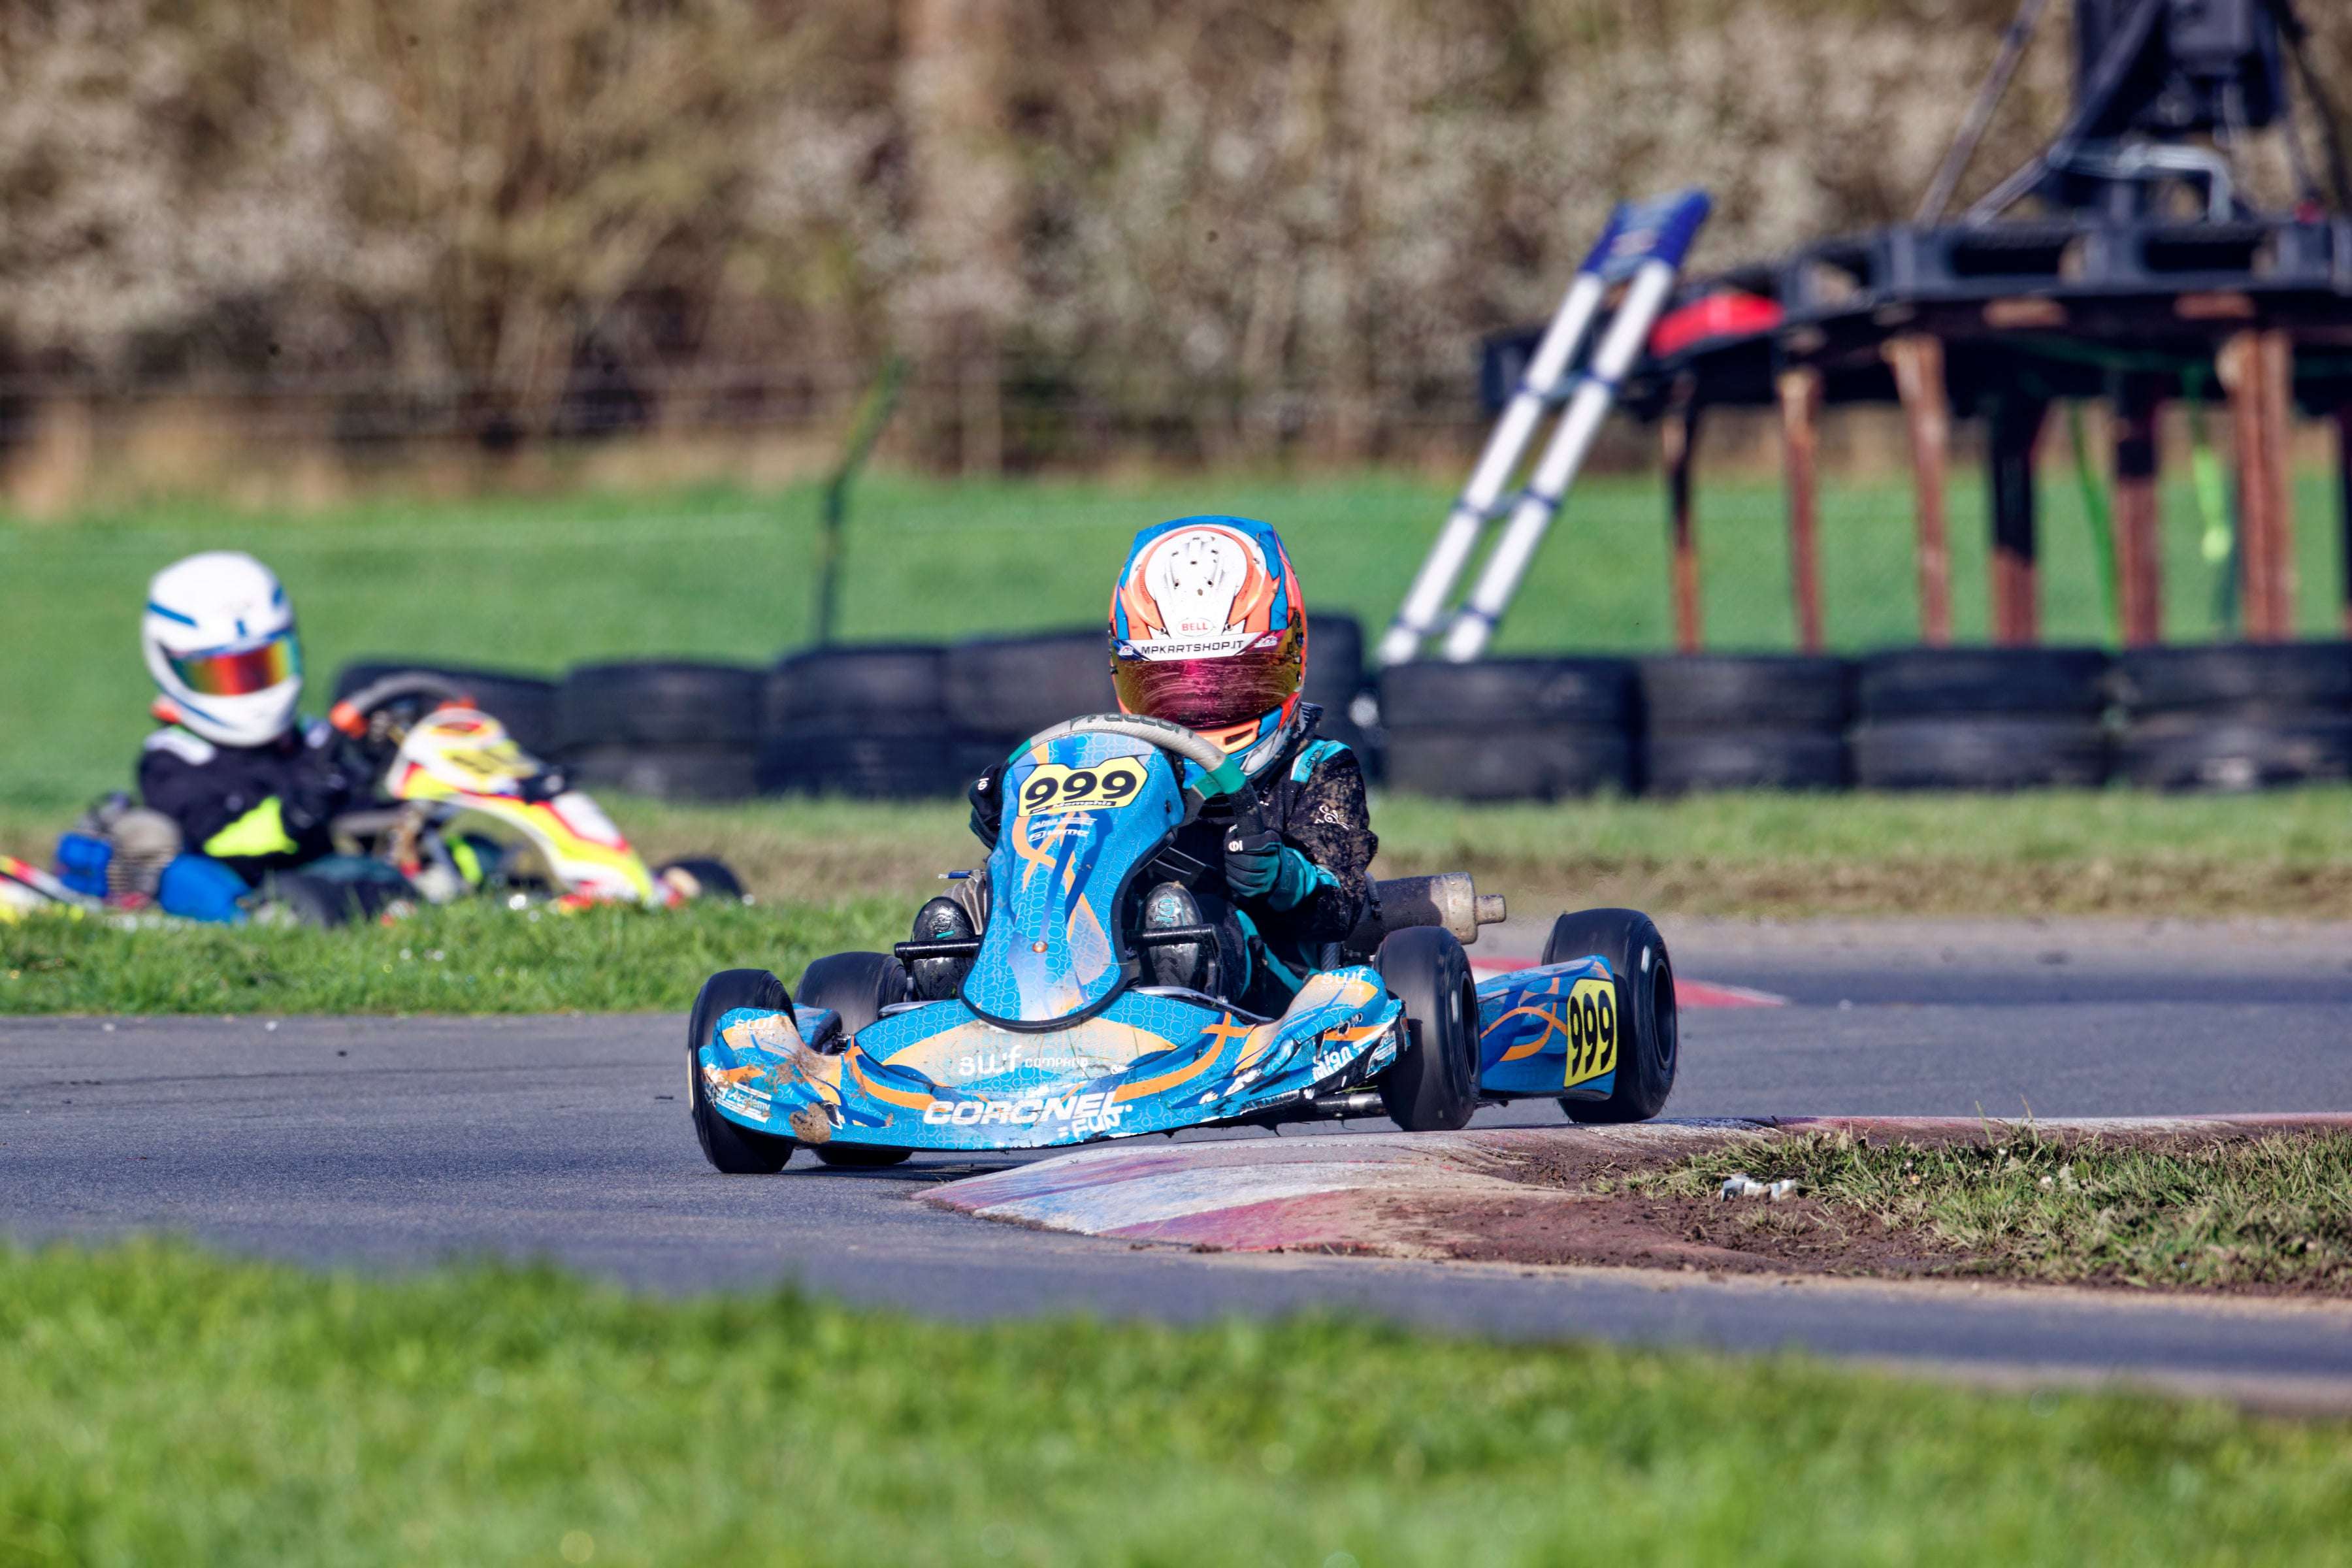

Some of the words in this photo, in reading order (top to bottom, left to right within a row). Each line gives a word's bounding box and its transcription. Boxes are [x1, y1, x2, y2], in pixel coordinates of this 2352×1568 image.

[1181, 622, 1208, 631] BELL
[1141, 640, 1245, 654] MPKARTSHOP.IT
[1025, 770, 1137, 810] 999
[1570, 989, 1614, 1077] 999
